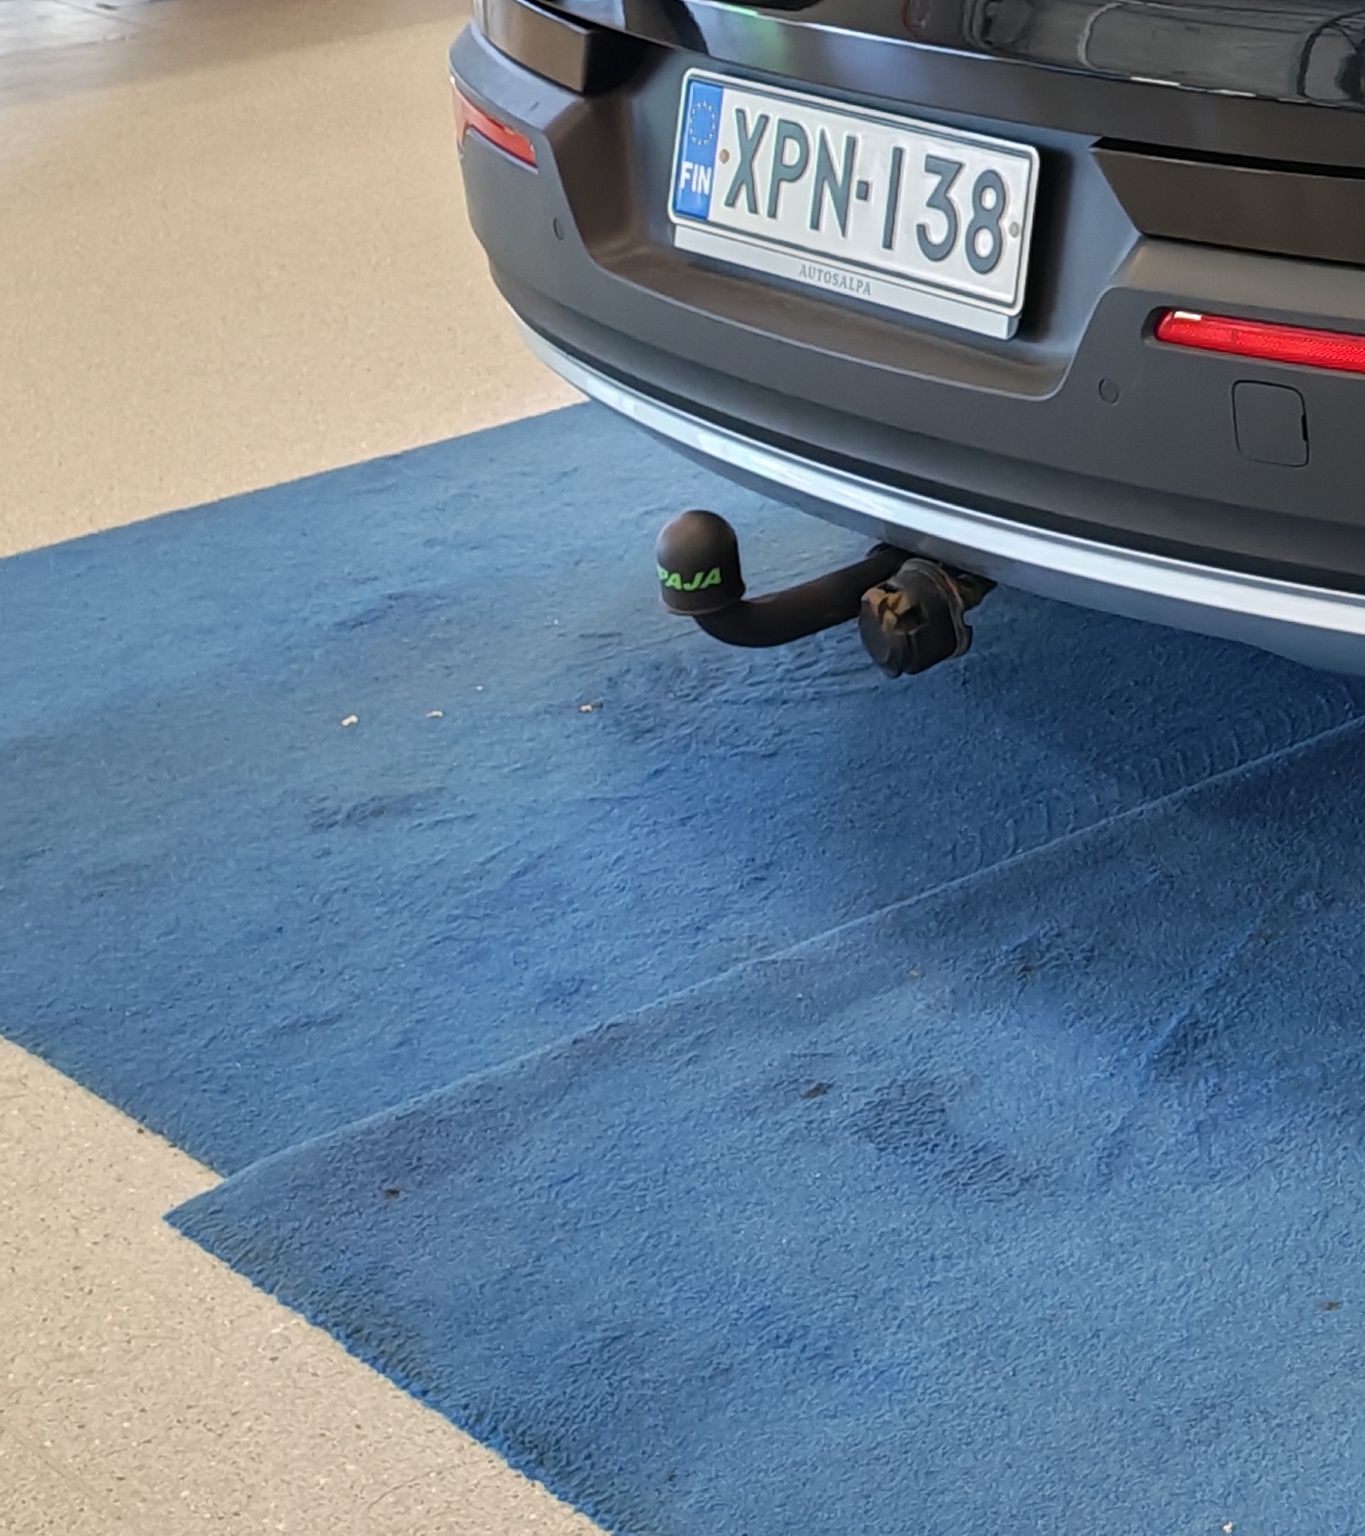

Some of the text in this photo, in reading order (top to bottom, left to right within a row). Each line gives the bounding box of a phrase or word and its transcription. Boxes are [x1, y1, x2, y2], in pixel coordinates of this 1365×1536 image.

[680, 160, 712, 196] FIN
[723, 107, 1007, 275] XPN-138
[798, 263, 873, 297] AUTOSALPA
